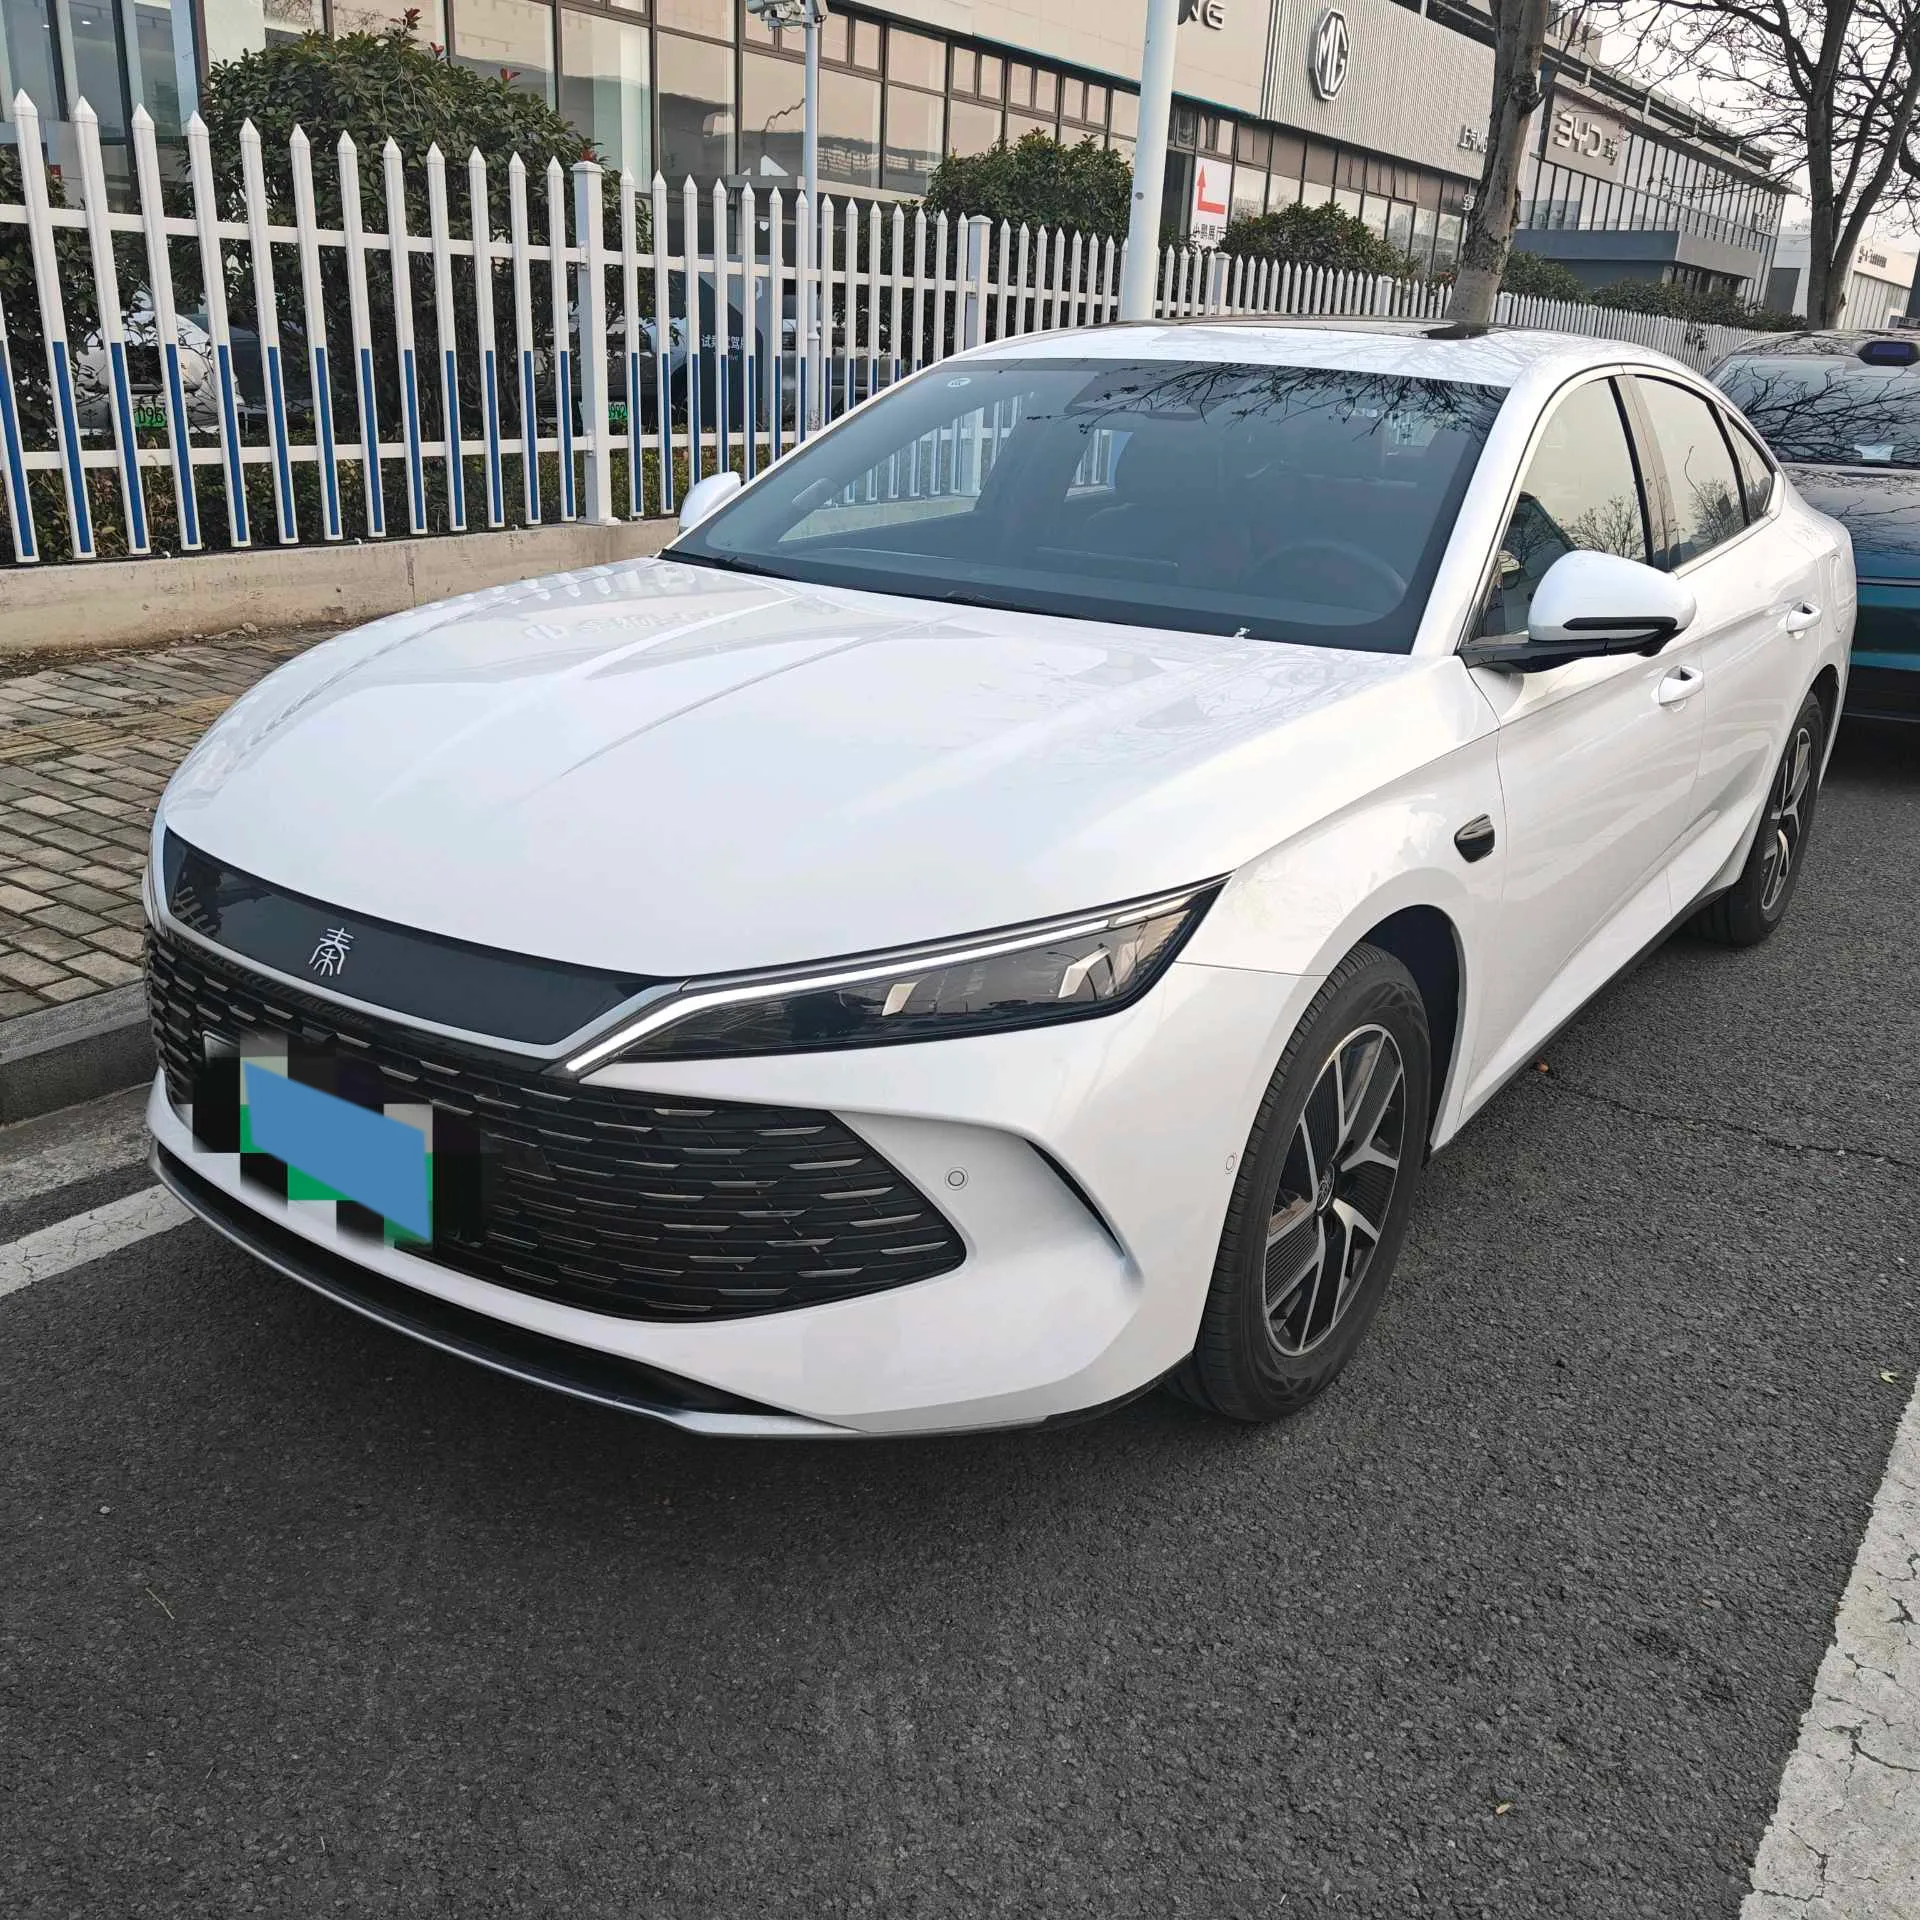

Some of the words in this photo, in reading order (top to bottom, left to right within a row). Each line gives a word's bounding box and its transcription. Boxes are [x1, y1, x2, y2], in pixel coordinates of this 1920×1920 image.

[1316, 11, 1348, 97] MG
[1554, 113, 1602, 158] BYD
[309, 927, 354, 976] 秦
